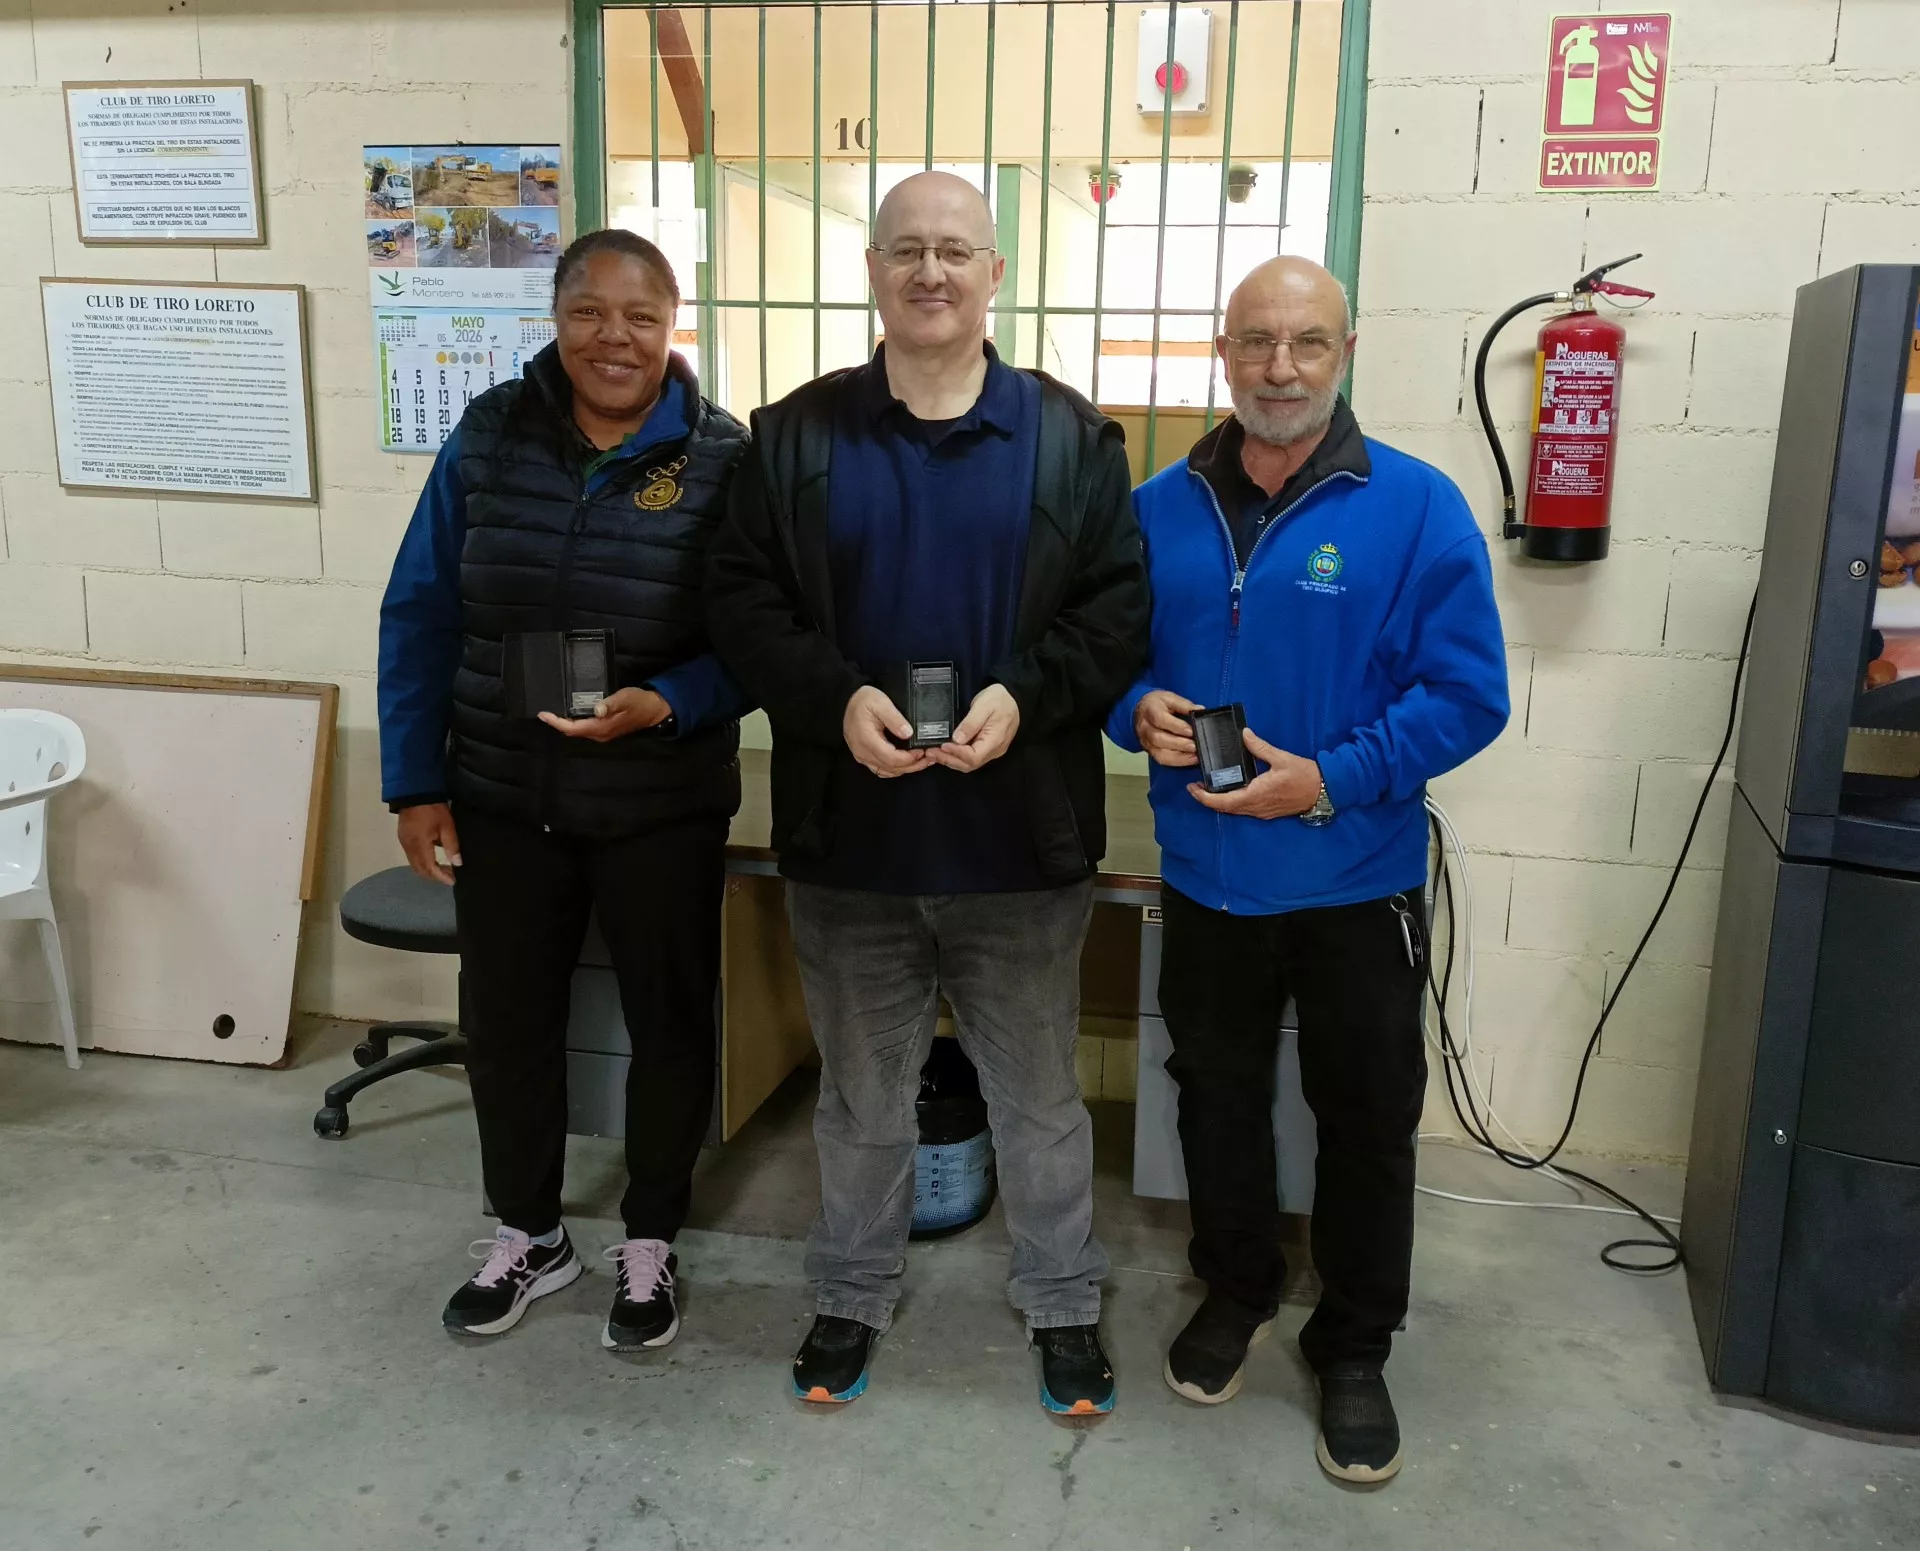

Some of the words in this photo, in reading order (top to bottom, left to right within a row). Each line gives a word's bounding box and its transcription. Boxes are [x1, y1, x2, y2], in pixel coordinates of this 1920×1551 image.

[101, 97, 127, 106] CLUB
[130, 97, 143, 105] DE
[147, 96, 171, 105] TIRO
[174, 95, 216, 105] LORETO
[834, 118, 878, 150] 10
[1547, 151, 1652, 176] EXTINTOR
[413, 277, 444, 286] Pablo
[413, 289, 464, 298] Montero
[86, 295, 124, 308] CLUB
[130, 297, 149, 309] DE
[154, 297, 189, 311] TIRO
[195, 299, 255, 313] LORETO
[87, 322, 125, 330] TIRADORES
[219, 327, 273, 336] INSTALACIONES
[164, 317, 217, 325] CUMPLIMIENTO
[452, 316, 485, 329] MAYO
[438, 334, 447, 342] 05
[456, 330, 483, 343] 2026
[1556, 342, 1609, 360] NOGUERAS
[489, 351, 494, 367] 1
[513, 352, 519, 368] 2
[392, 369, 398, 385] 4
[416, 369, 422, 385] 5
[440, 370, 446, 386] 6
[464, 371, 470, 386] 7
[489, 371, 495, 386] 8
[391, 388, 400, 404] 11
[415, 389, 425, 405] 12
[439, 390, 449, 406] 13
[463, 390, 473, 406] 14
[391, 408, 401, 424] 18
[415, 409, 426, 425] 19
[439, 409, 450, 425] 20
[392, 428, 403, 443] 25
[416, 429, 427, 444] 26
[1552, 461, 1589, 476] NOGUERAS
